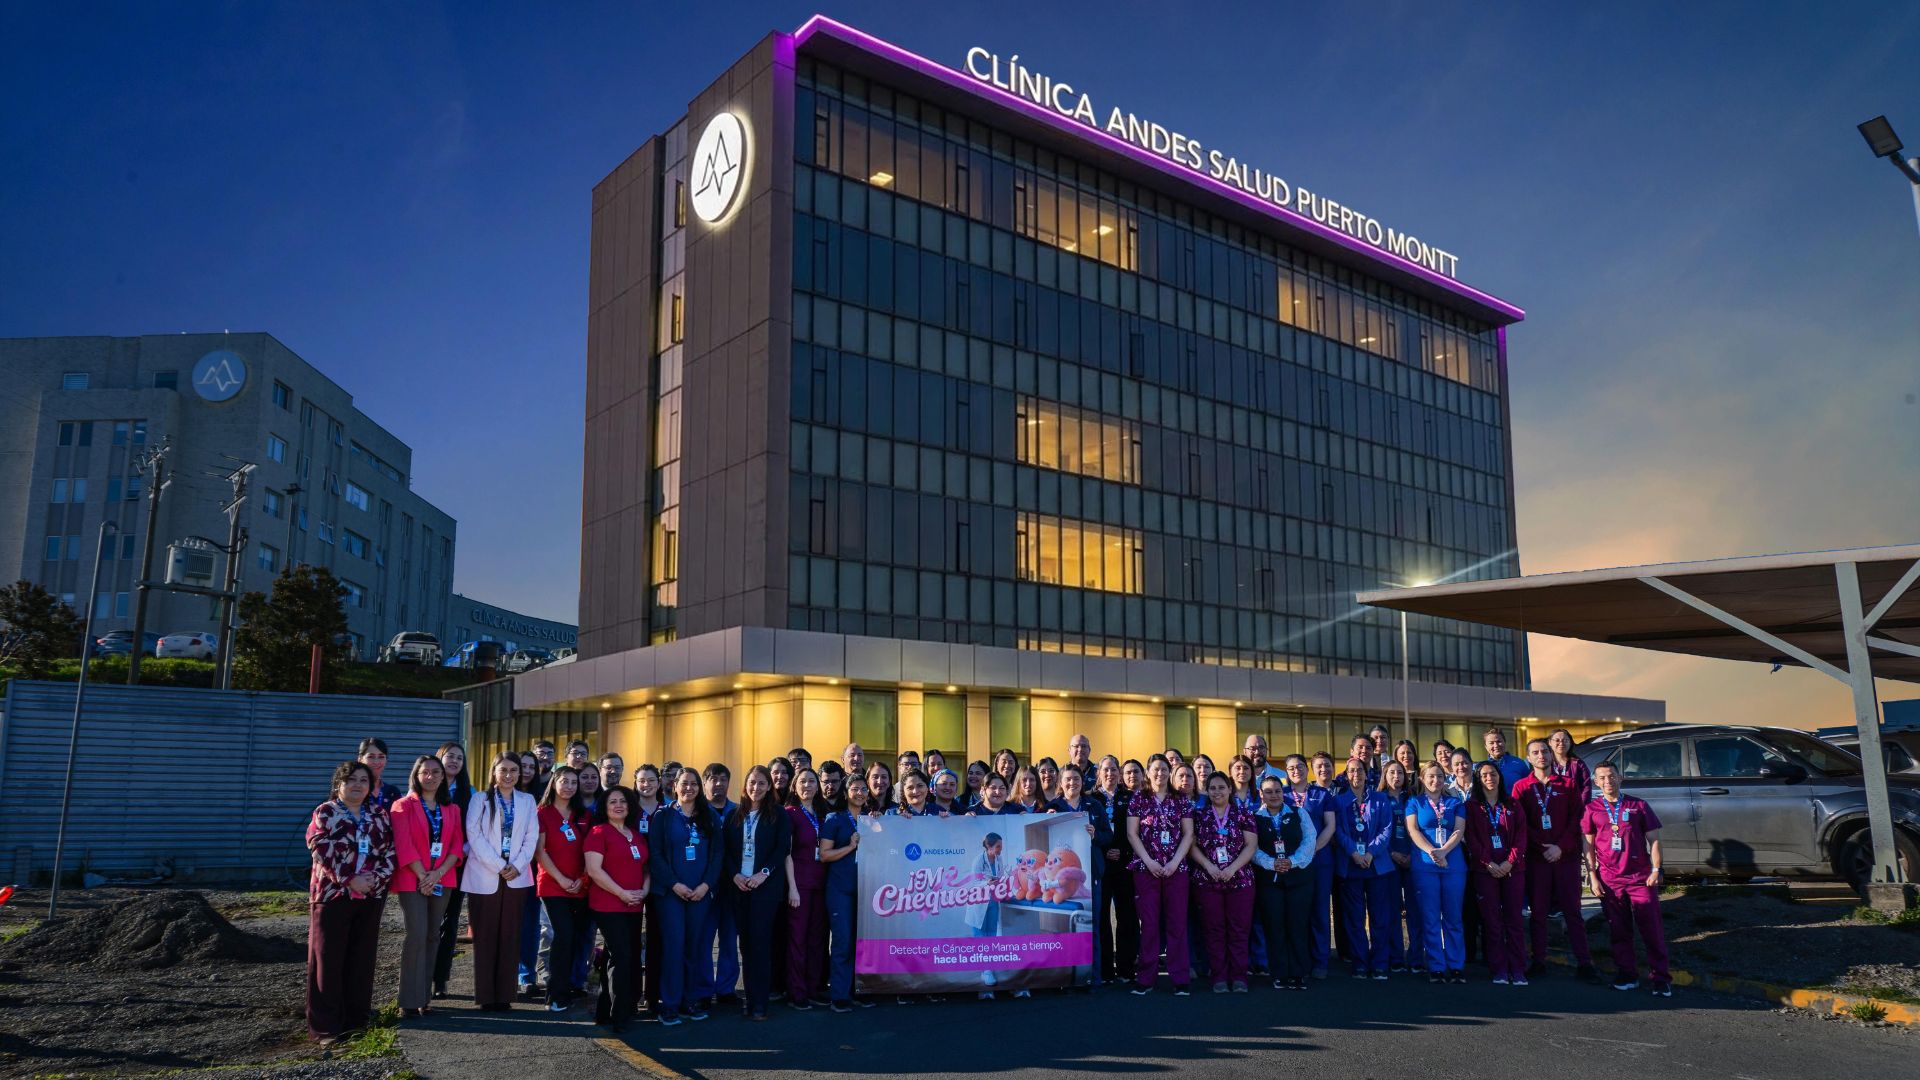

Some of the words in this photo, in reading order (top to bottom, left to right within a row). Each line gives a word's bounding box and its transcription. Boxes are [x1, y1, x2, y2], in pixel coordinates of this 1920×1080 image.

[966, 46, 1097, 127] CLÍNICA
[1106, 106, 1203, 171] ANDES
[1208, 149, 1291, 207] SALUD
[1297, 187, 1383, 246] PUERTO
[1387, 227, 1459, 278] MONTT
[508, 620, 540, 638] ANDES
[542, 628, 578, 644] SALUD
[872, 874, 1016, 916] Chequearé!
[889, 944, 930, 955] Detectar
[932, 944, 940, 953] el
[942, 943, 975, 954] Cáncer
[977, 943, 989, 953] de
[991, 942, 1020, 952] Mama
[1021, 943, 1028, 951] a
[934, 954, 957, 964] hace
[959, 953, 968, 963] la
[969, 952, 1021, 963] diferencia.
